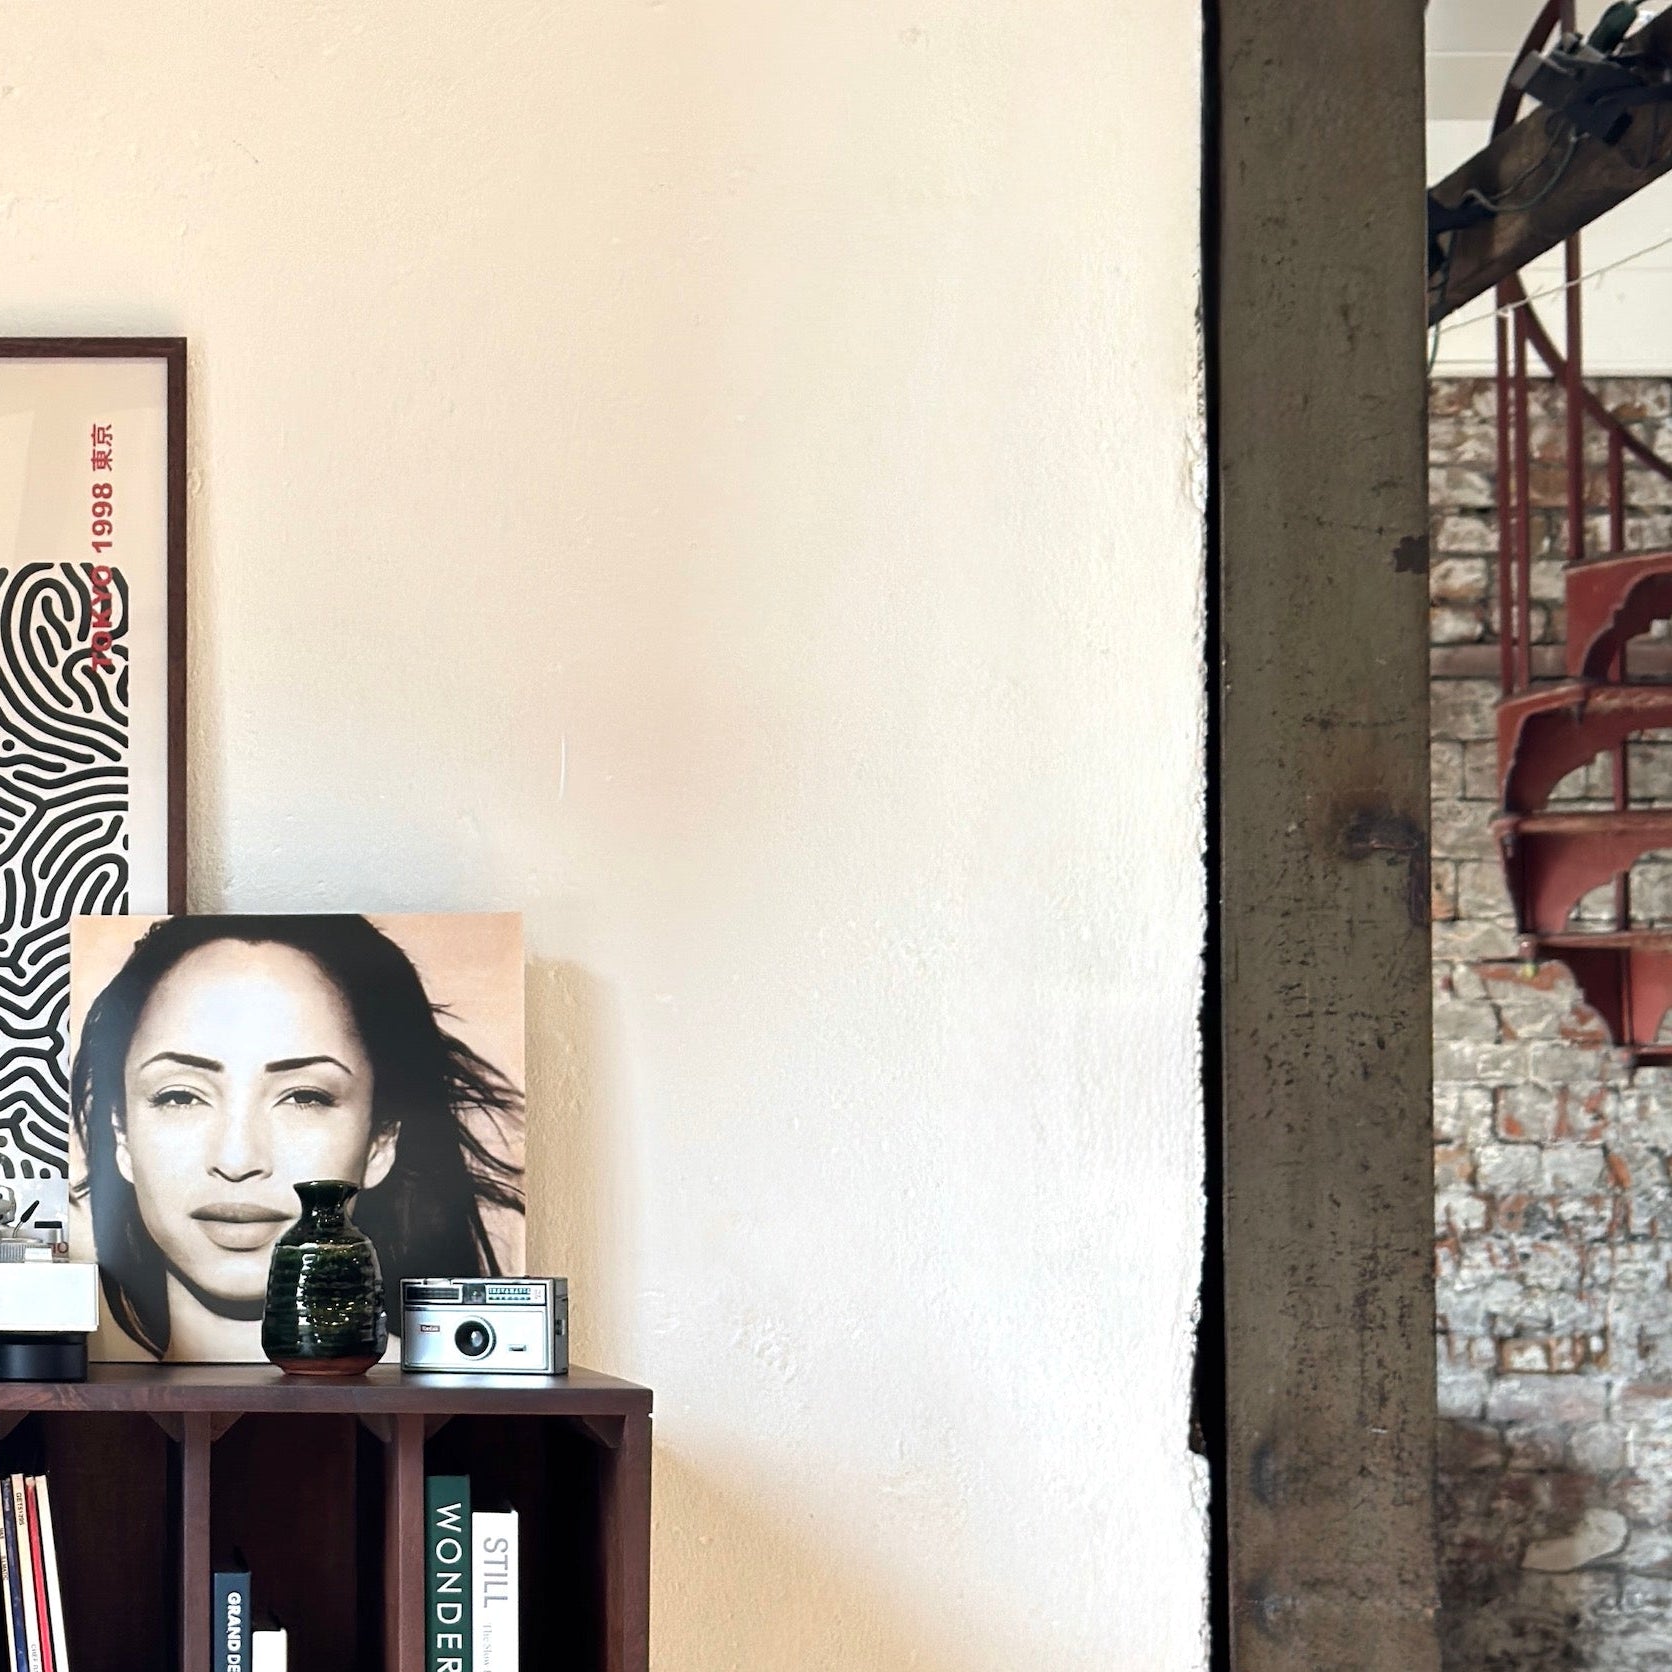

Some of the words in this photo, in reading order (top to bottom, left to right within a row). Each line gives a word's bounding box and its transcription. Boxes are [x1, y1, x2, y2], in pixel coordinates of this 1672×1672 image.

[91, 423, 114, 471] 東京
[92, 483, 114, 553] 1998
[91, 564, 115, 672] TOKYO
[483, 1536, 508, 1608] STILL
[226, 1592, 242, 1651] GRAND
[483, 1624, 492, 1643] The
